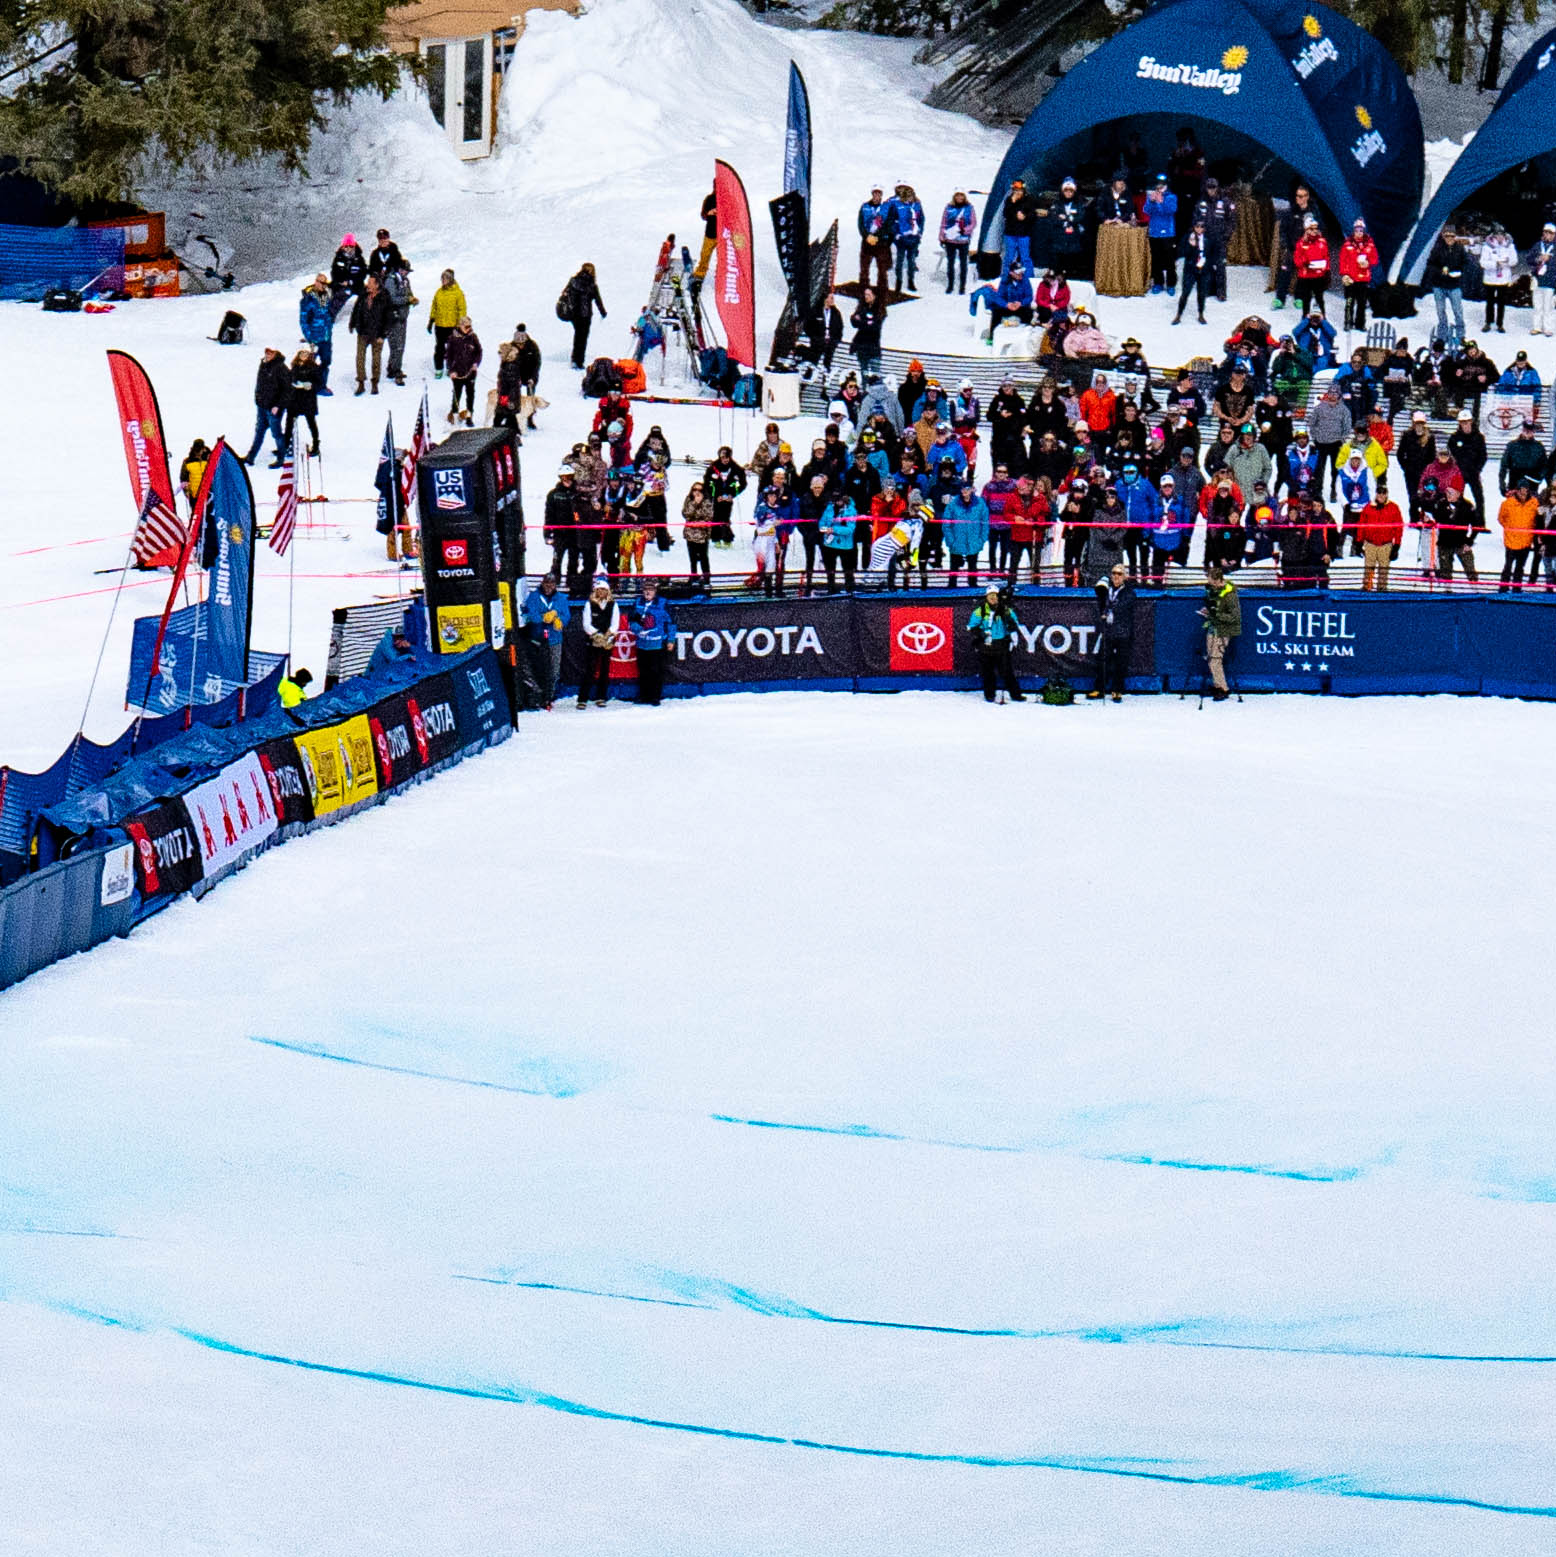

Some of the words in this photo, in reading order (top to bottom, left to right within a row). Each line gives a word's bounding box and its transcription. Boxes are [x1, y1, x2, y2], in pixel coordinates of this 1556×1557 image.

[437, 471, 463, 486] US
[437, 568, 476, 578] TOYOTA
[1256, 605, 1356, 639] STIFEL
[1256, 643, 1282, 655] U.S.
[1285, 644, 1309, 656] SKI
[1313, 645, 1355, 657] TEAM
